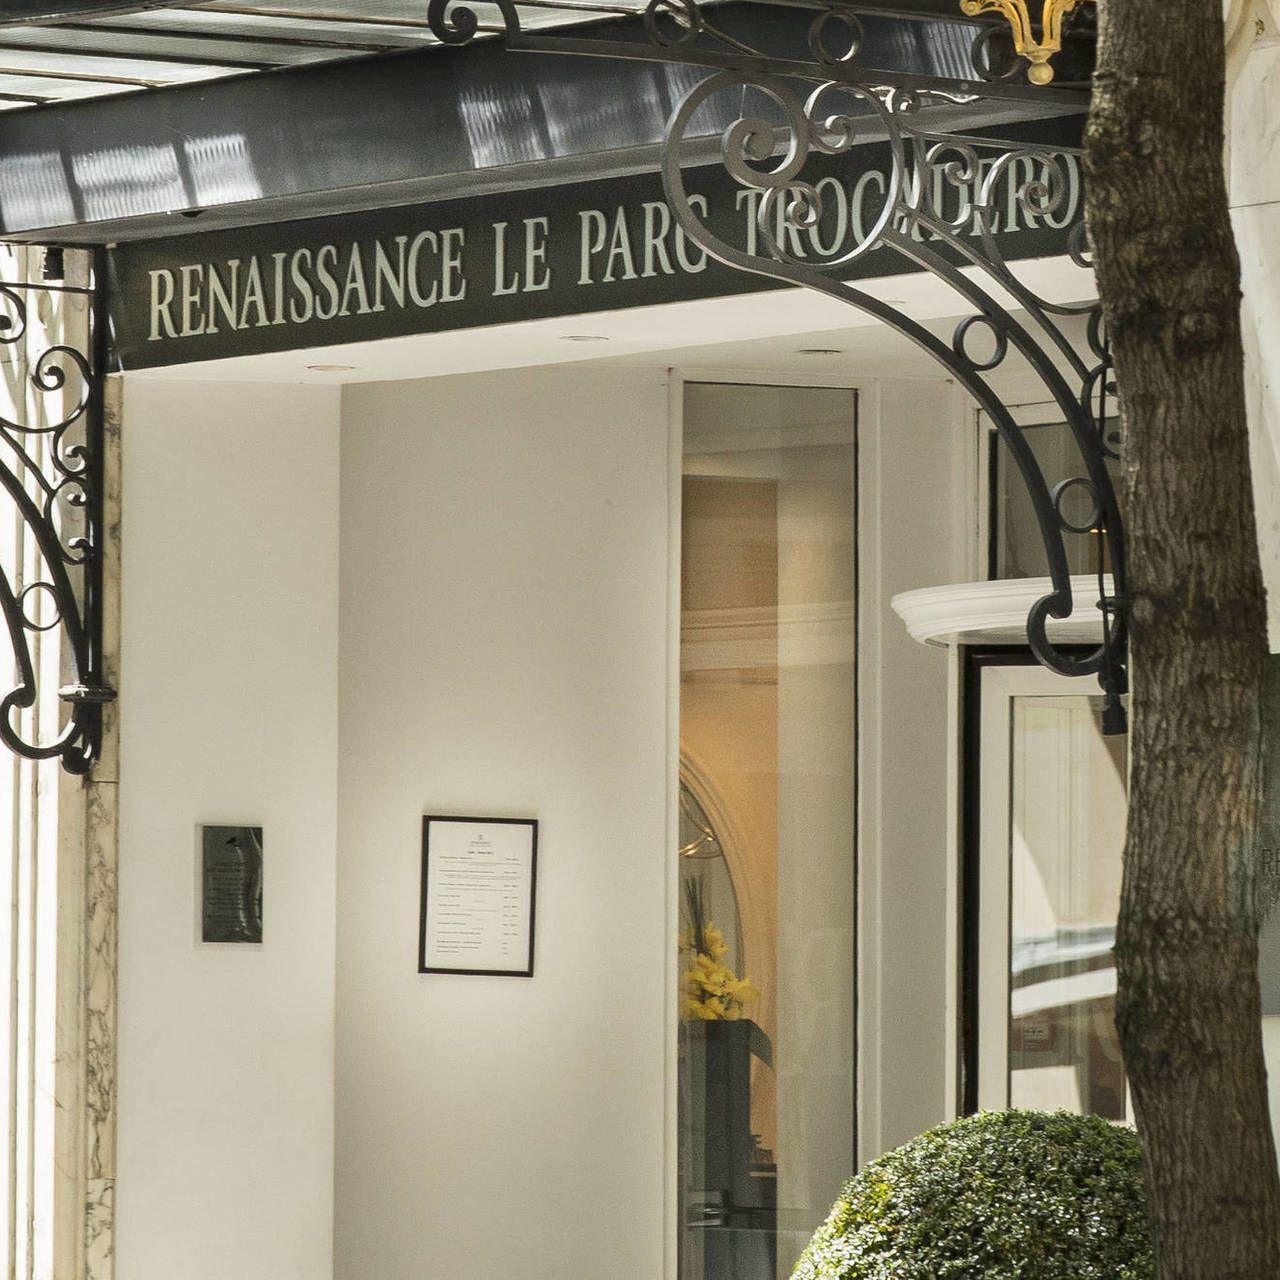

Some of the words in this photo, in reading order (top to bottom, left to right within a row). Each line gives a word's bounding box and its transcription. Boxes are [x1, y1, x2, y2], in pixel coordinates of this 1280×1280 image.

[147, 226, 468, 341] RENAISSANCE
[491, 215, 551, 296] LE
[575, 193, 711, 287] PARC
